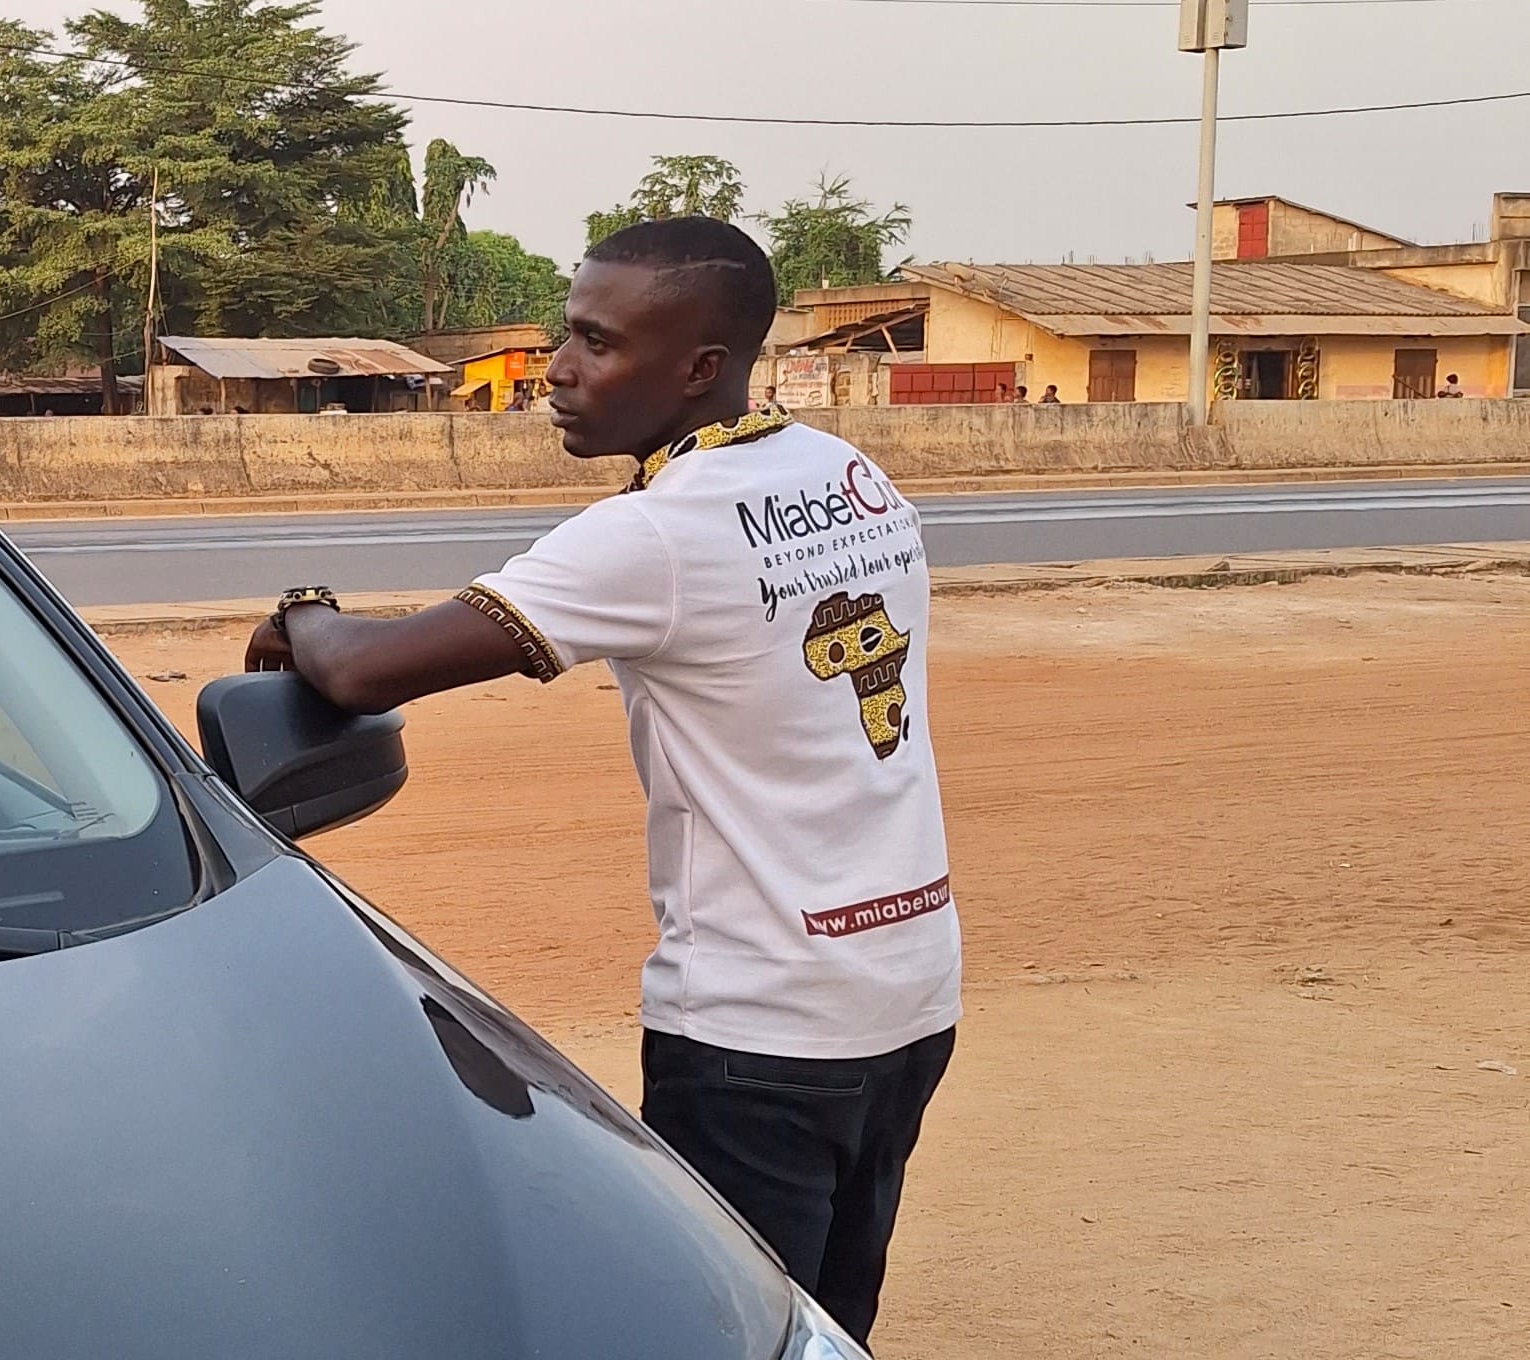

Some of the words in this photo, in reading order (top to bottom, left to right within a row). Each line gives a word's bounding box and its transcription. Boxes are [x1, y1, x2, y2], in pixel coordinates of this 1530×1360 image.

[764, 543, 825, 569] BEYOND
[757, 576, 807, 623] Your
[803, 554, 860, 592] trusted
[859, 552, 893, 578] tour
